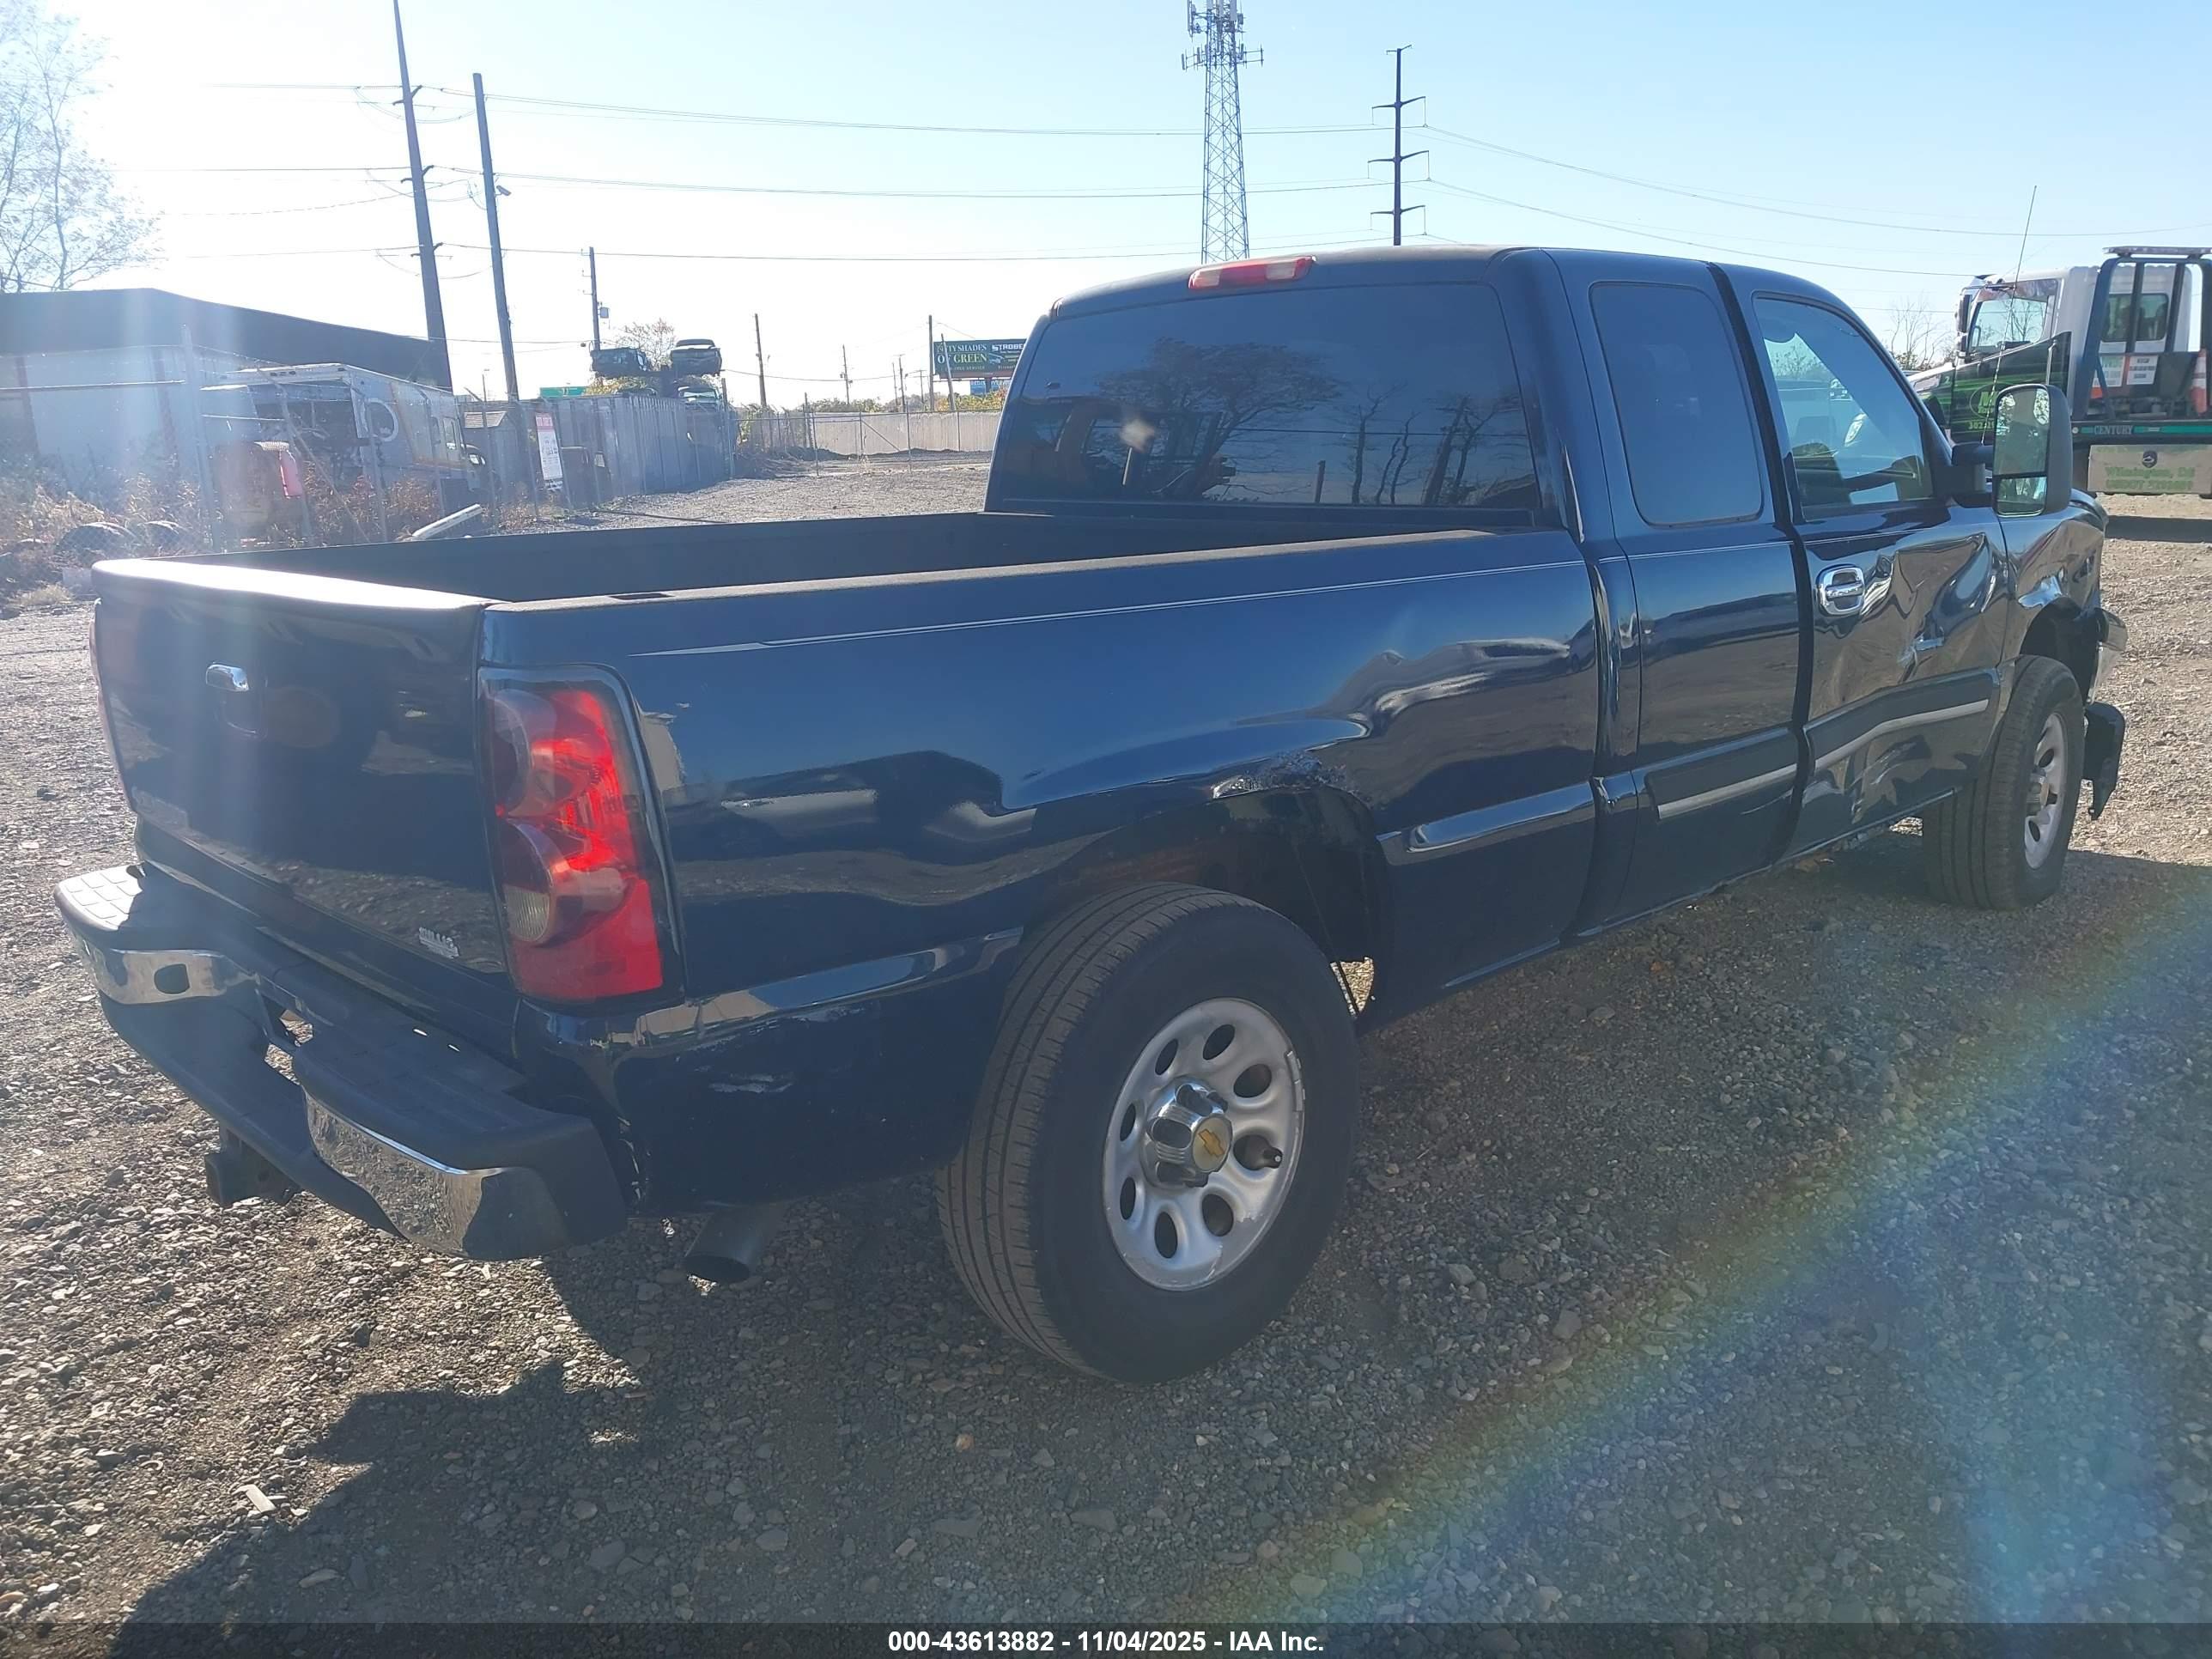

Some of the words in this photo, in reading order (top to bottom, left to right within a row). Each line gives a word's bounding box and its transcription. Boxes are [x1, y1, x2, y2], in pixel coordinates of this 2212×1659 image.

[957, 343, 987, 352] SHADES
[953, 353, 988, 363] GREEN
[2094, 425, 2133, 434] CENTURY
